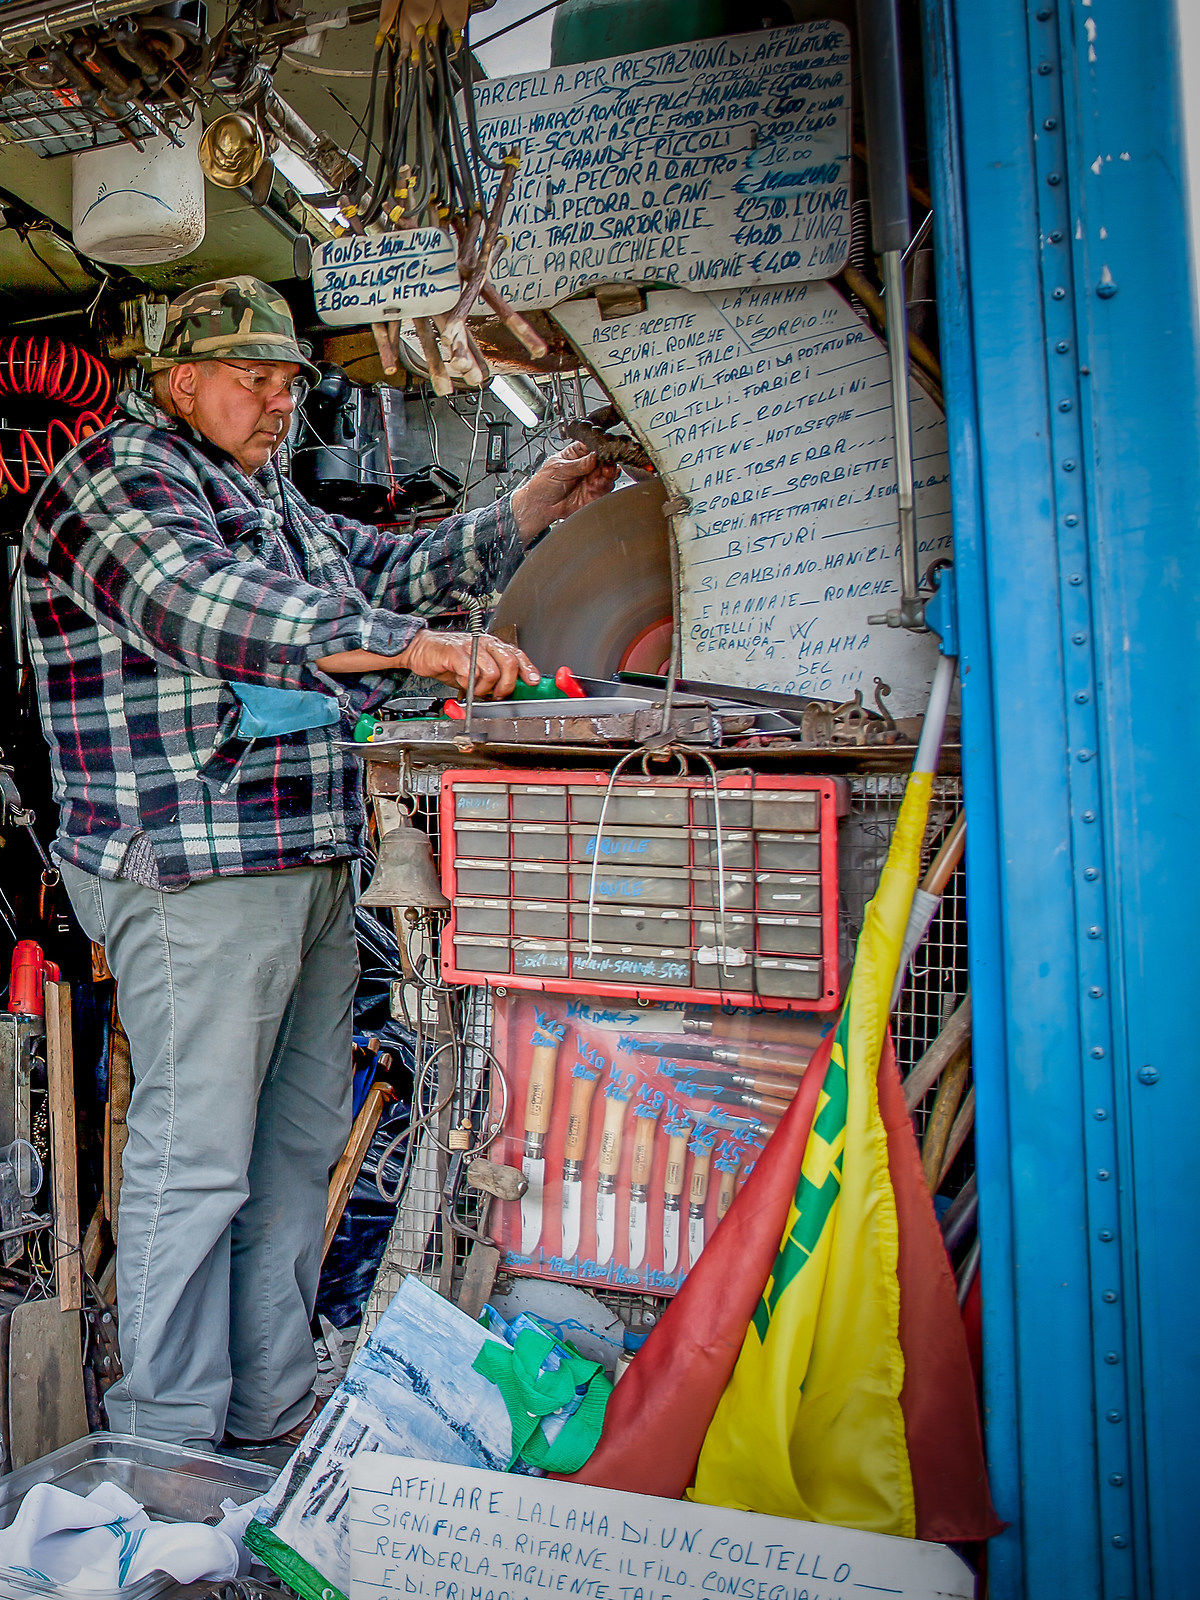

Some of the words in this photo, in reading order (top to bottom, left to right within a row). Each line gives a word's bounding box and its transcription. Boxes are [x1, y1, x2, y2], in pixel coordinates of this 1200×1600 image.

[574, 66, 607, 91] PER
[612, 40, 726, 83] PRESTAZIONI
[655, 129, 731, 156] PICCOLI
[563, 192, 631, 219] PECORA
[663, 177, 712, 206] CANI
[593, 206, 708, 241] SARTORIALE
[544, 234, 691, 274] PARRUCCHIERE
[360, 258, 427, 287] ELASTICI
[367, 289, 386, 306] AL
[393, 283, 437, 300] METRO
[723, 296, 739, 310] LA
[736, 313, 764, 329] DEL
[798, 330, 864, 361] POTATURA
[650, 394, 732, 430] COLTELLI
[743, 366, 811, 399] FORBICI
[666, 416, 739, 449] TRAFILE
[756, 375, 868, 422] COLTELLINI
[766, 407, 854, 446] MOTOSEGHE
[727, 523, 817, 557] BISTURI
[823, 579, 894, 602] RONCHE
[690, 616, 752, 641] COLTELLI
[371, 1503, 481, 1545] SIGNIFICA
[491, 1533, 502, 1549] A
[515, 1532, 610, 1570] RIFARNE
[618, 1552, 638, 1577] IL
[643, 1558, 688, 1587] FILO
[391, 1475, 504, 1514] AFFILARE
[516, 1496, 544, 1522] LA
[549, 1504, 609, 1538] LAMA
[660, 1527, 702, 1553] UN
[708, 1536, 851, 1584] COLTELLO
[375, 1535, 491, 1577] RENDERLA
[502, 1560, 611, 1600] TAGLIENTE
